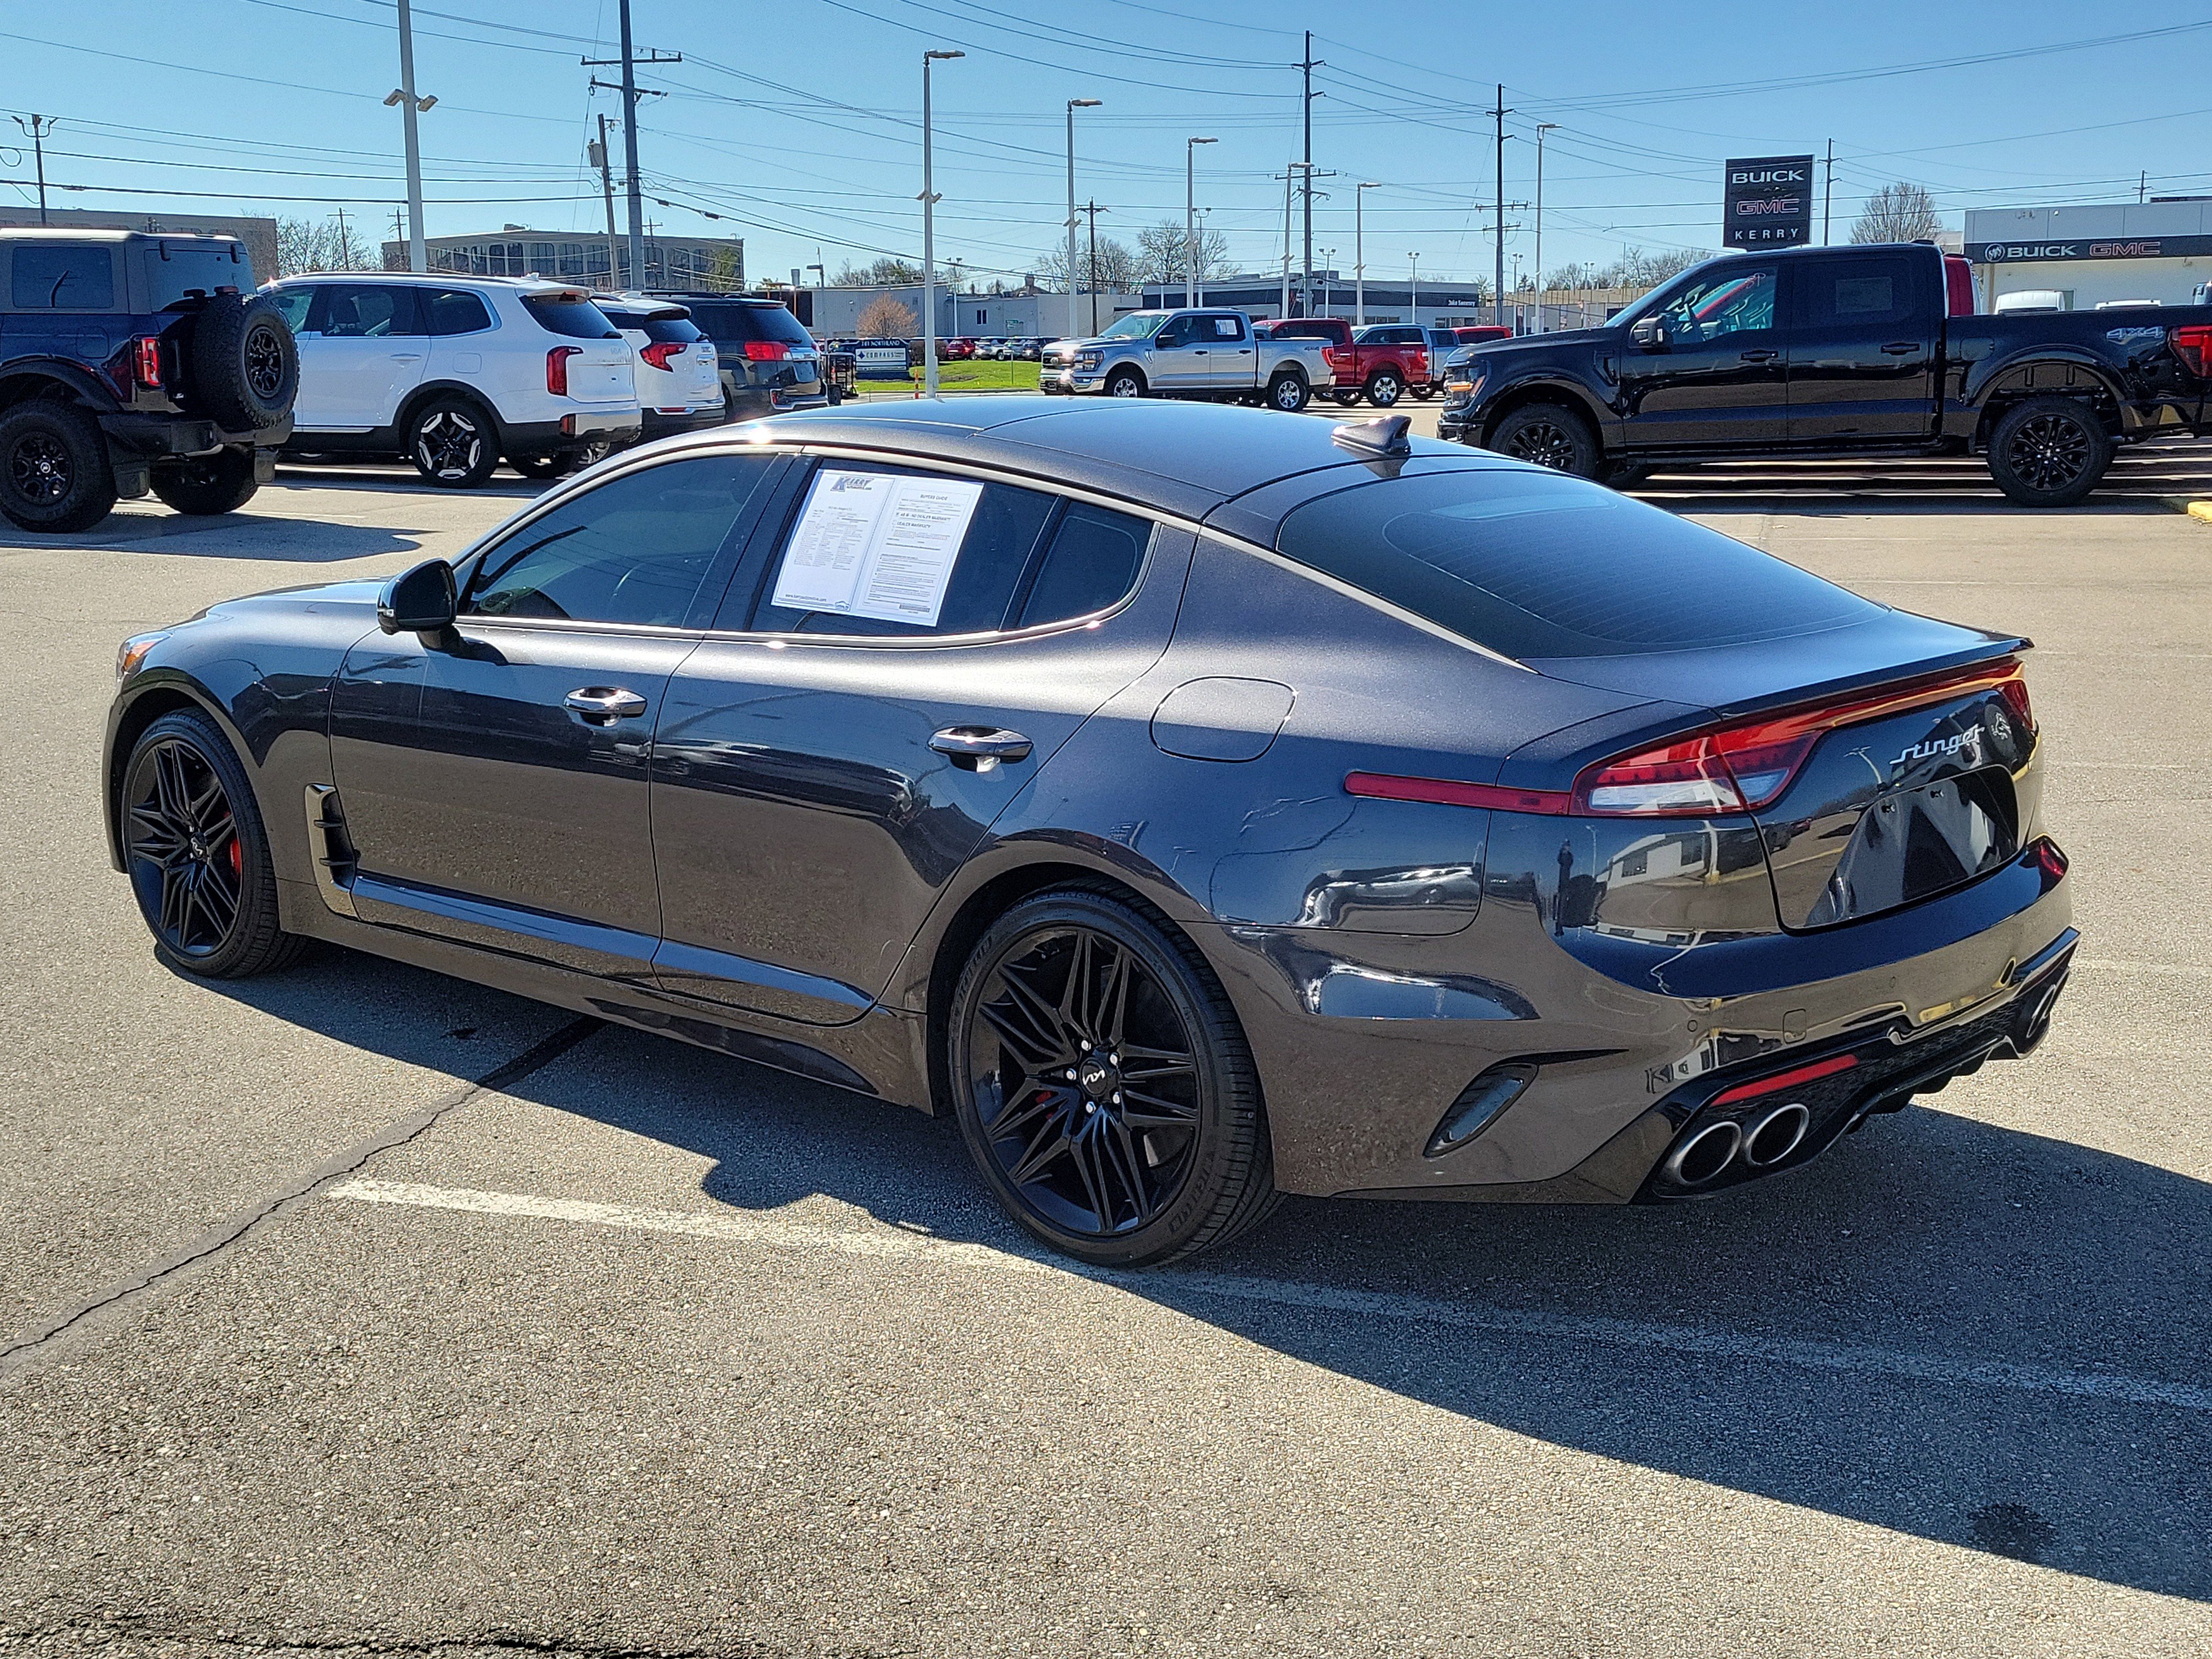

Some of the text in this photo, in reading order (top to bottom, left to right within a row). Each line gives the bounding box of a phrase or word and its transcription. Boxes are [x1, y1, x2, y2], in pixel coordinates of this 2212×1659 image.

[1731, 170, 1805, 184] BUICK
[1736, 198, 1799, 216] GMC
[1734, 228, 1799, 240] KERRY
[2006, 244, 2078, 258] BUICK
[2089, 241, 2161, 257] GMC
